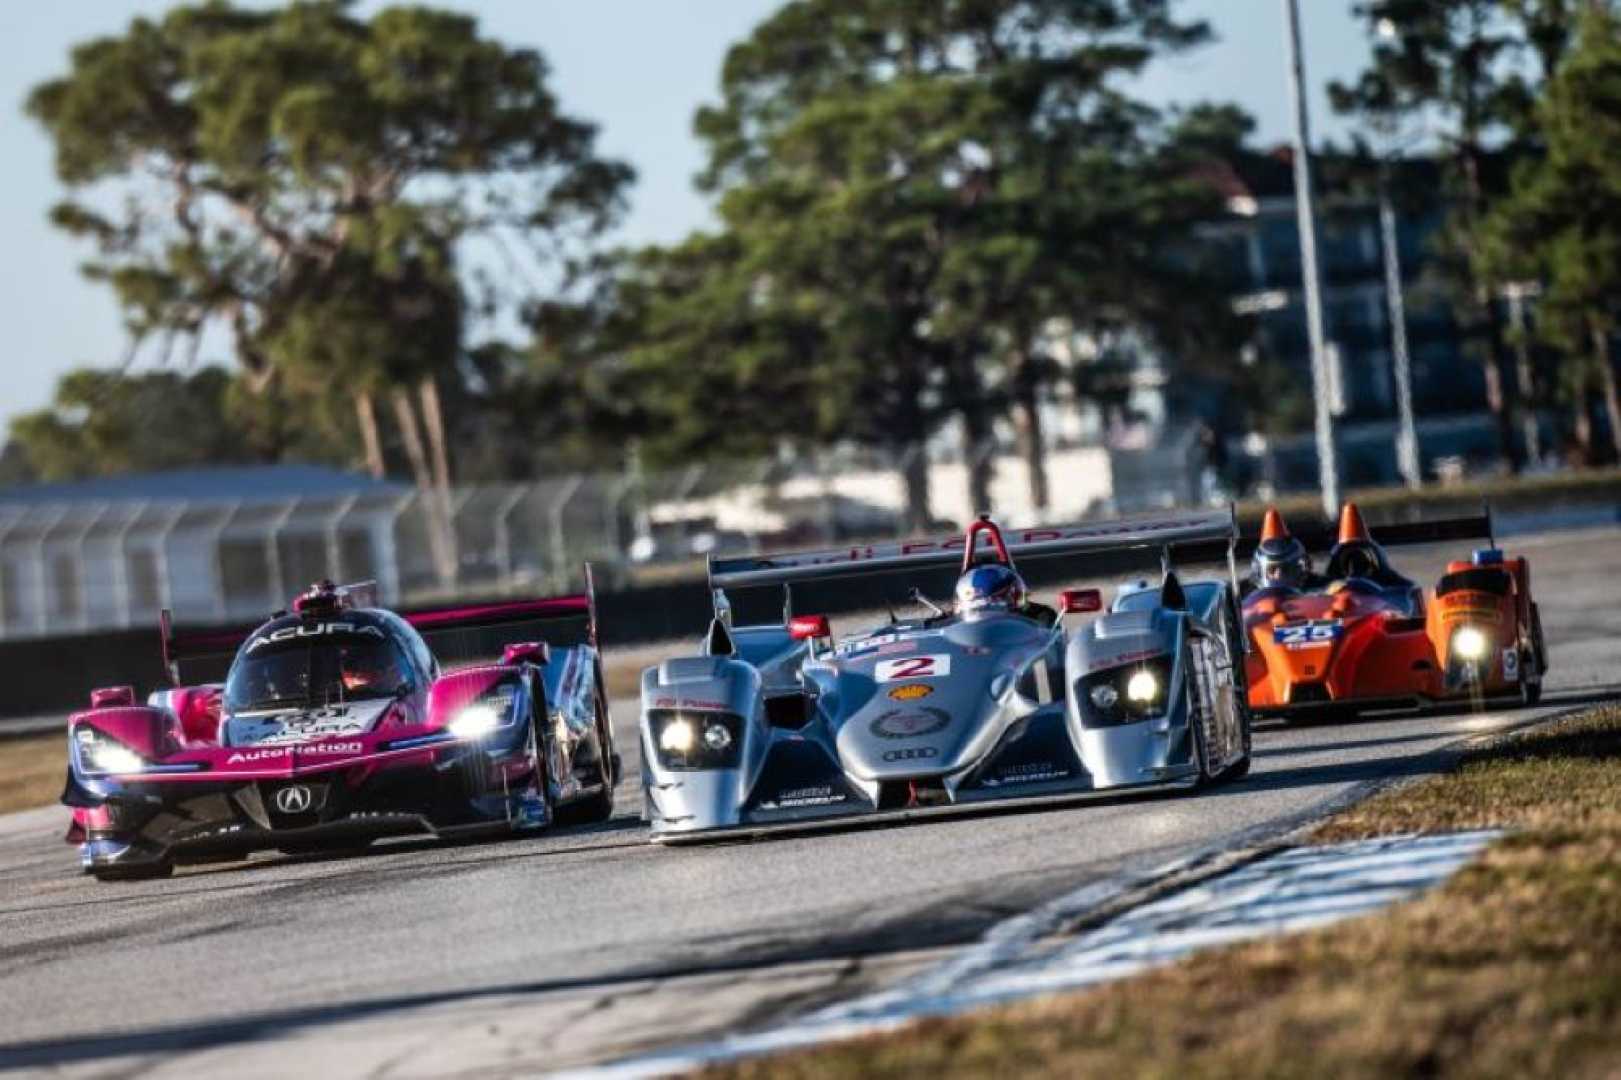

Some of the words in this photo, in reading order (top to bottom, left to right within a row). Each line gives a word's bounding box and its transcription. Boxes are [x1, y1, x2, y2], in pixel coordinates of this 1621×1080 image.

[246, 622, 387, 654] ACURA
[1281, 624, 1334, 642] 25
[887, 656, 936, 679] 2
[226, 742, 363, 765] AutoNation
